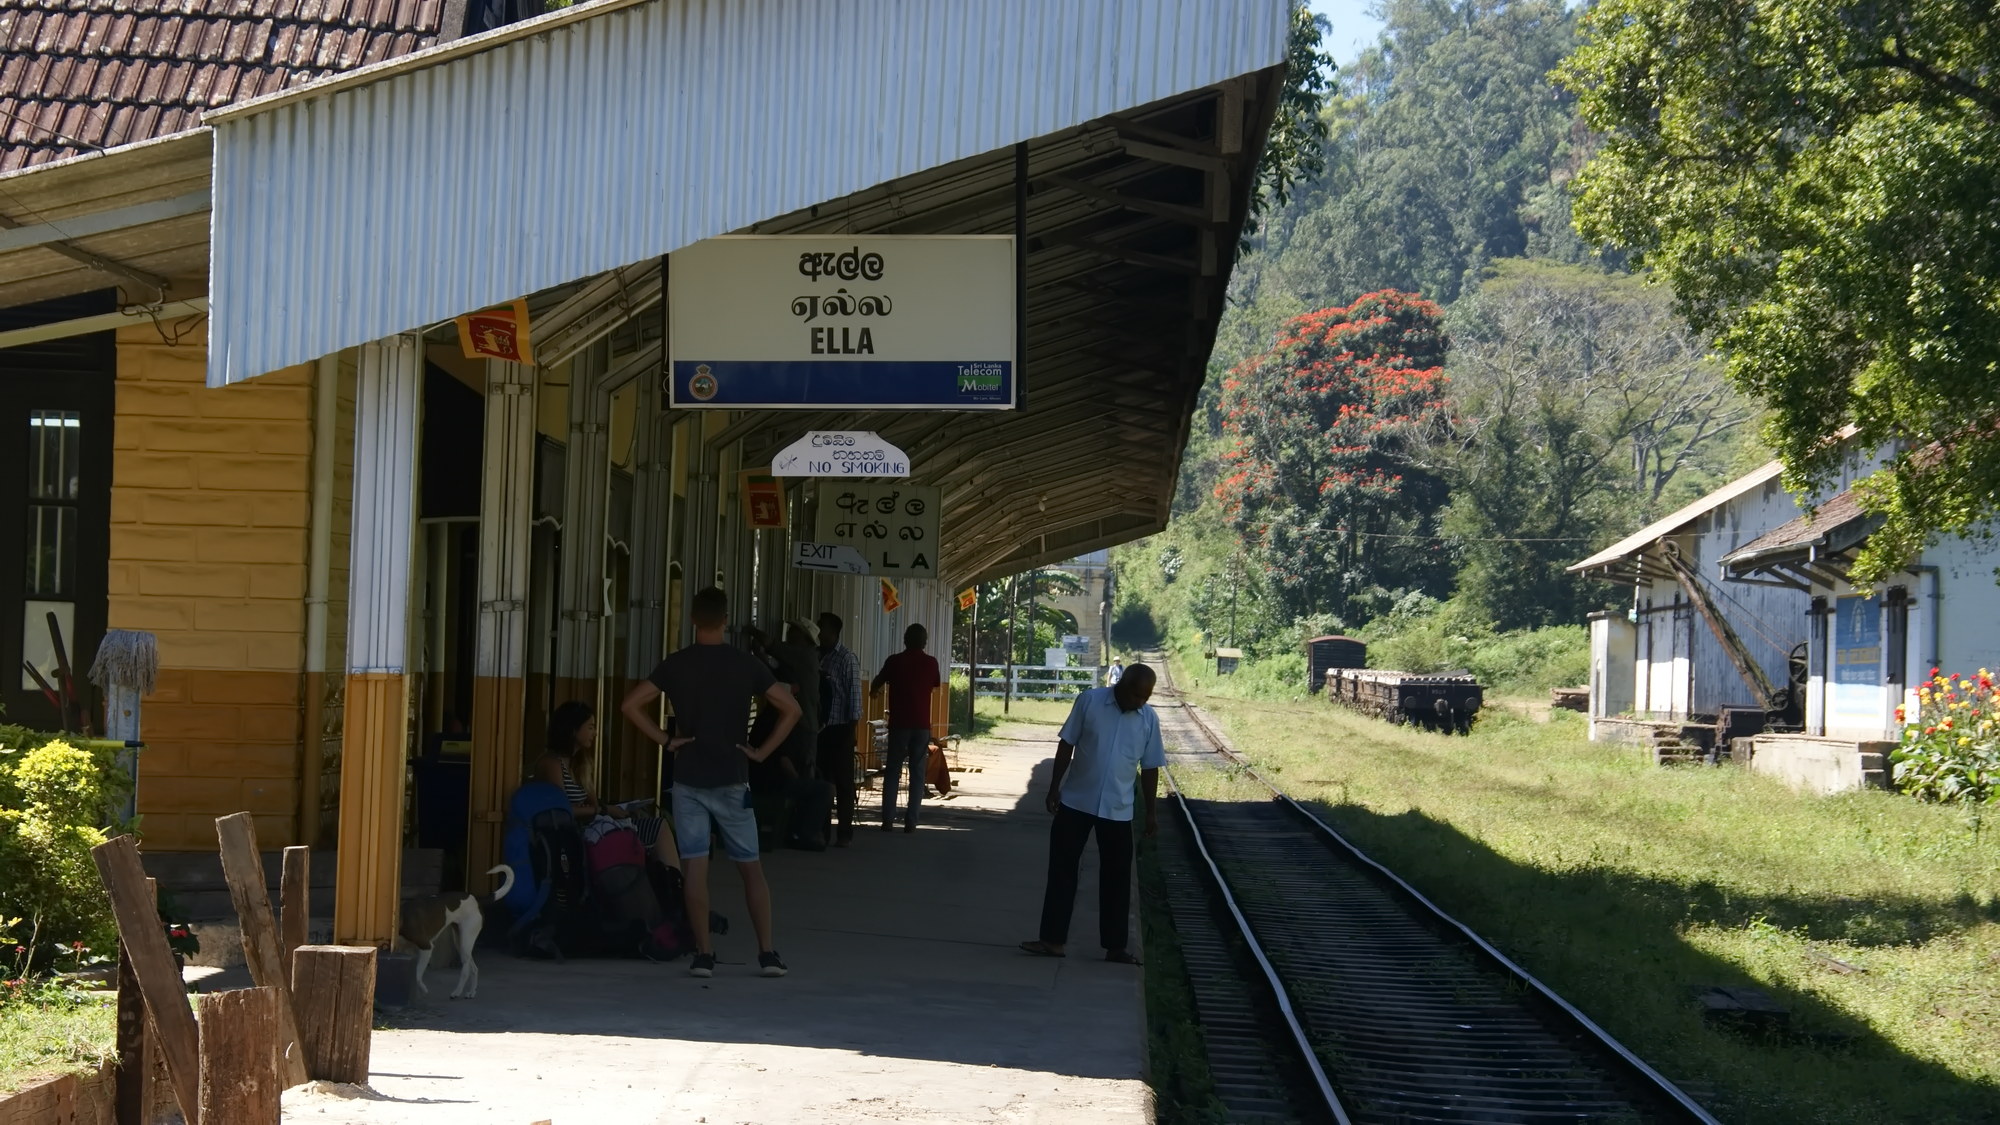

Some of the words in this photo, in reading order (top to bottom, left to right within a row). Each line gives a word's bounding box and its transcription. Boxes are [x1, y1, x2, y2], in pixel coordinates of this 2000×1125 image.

[799, 246, 884, 282] ඇල්ල
[811, 327, 874, 354] ELLA
[957, 364, 1001, 376] Telecom
[961, 379, 998, 392] Mobitel
[809, 461, 832, 473] NO
[841, 461, 905, 474] SMOKING
[800, 542, 837, 560] EXIT
